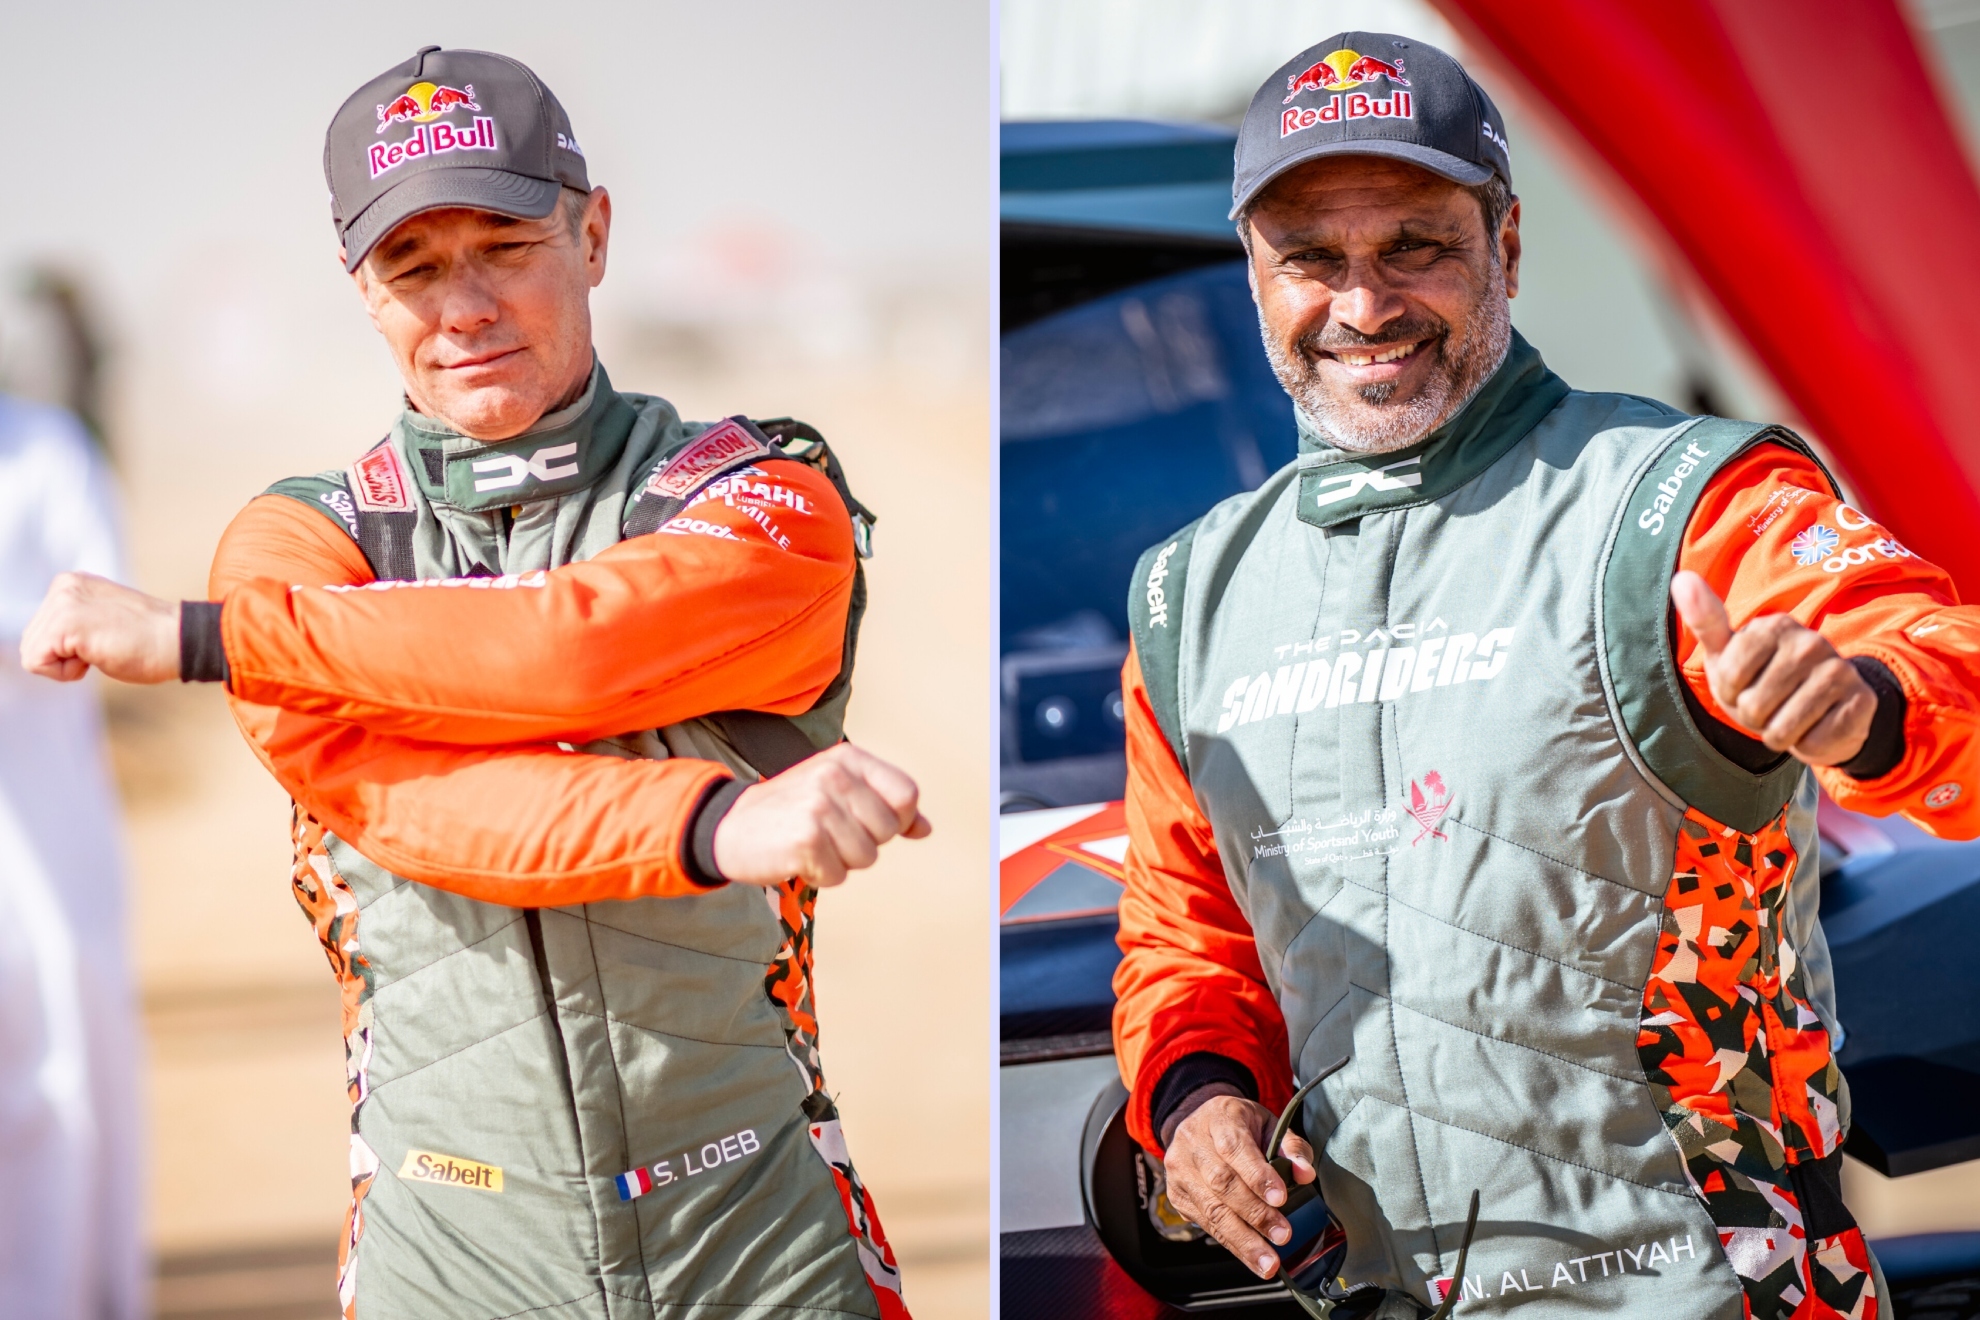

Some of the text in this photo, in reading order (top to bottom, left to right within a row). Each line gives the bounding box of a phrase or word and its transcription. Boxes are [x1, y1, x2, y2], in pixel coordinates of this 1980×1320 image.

[1280, 90, 1412, 139] Red Bull
[368, 116, 497, 179] Red Bull
[1638, 439, 1710, 535] Sabelt
[320, 490, 358, 540] Sab
[1753, 507, 1783, 537] Ministry
[1780, 496, 1789, 507] of
[1147, 541, 1177, 628] Sabelt
[1274, 616, 1448, 660] THE DACIA
[1217, 626, 1516, 734] SANDRIDERS
[1254, 845, 1290, 859] Ministry
[1293, 838, 1305, 852] of
[1361, 825, 1399, 842] Youth
[412, 1154, 492, 1188] Sabelt
[653, 1129, 760, 1187] S. LOEB
[1460, 1235, 1695, 1301] N. AL ATTIYAH
